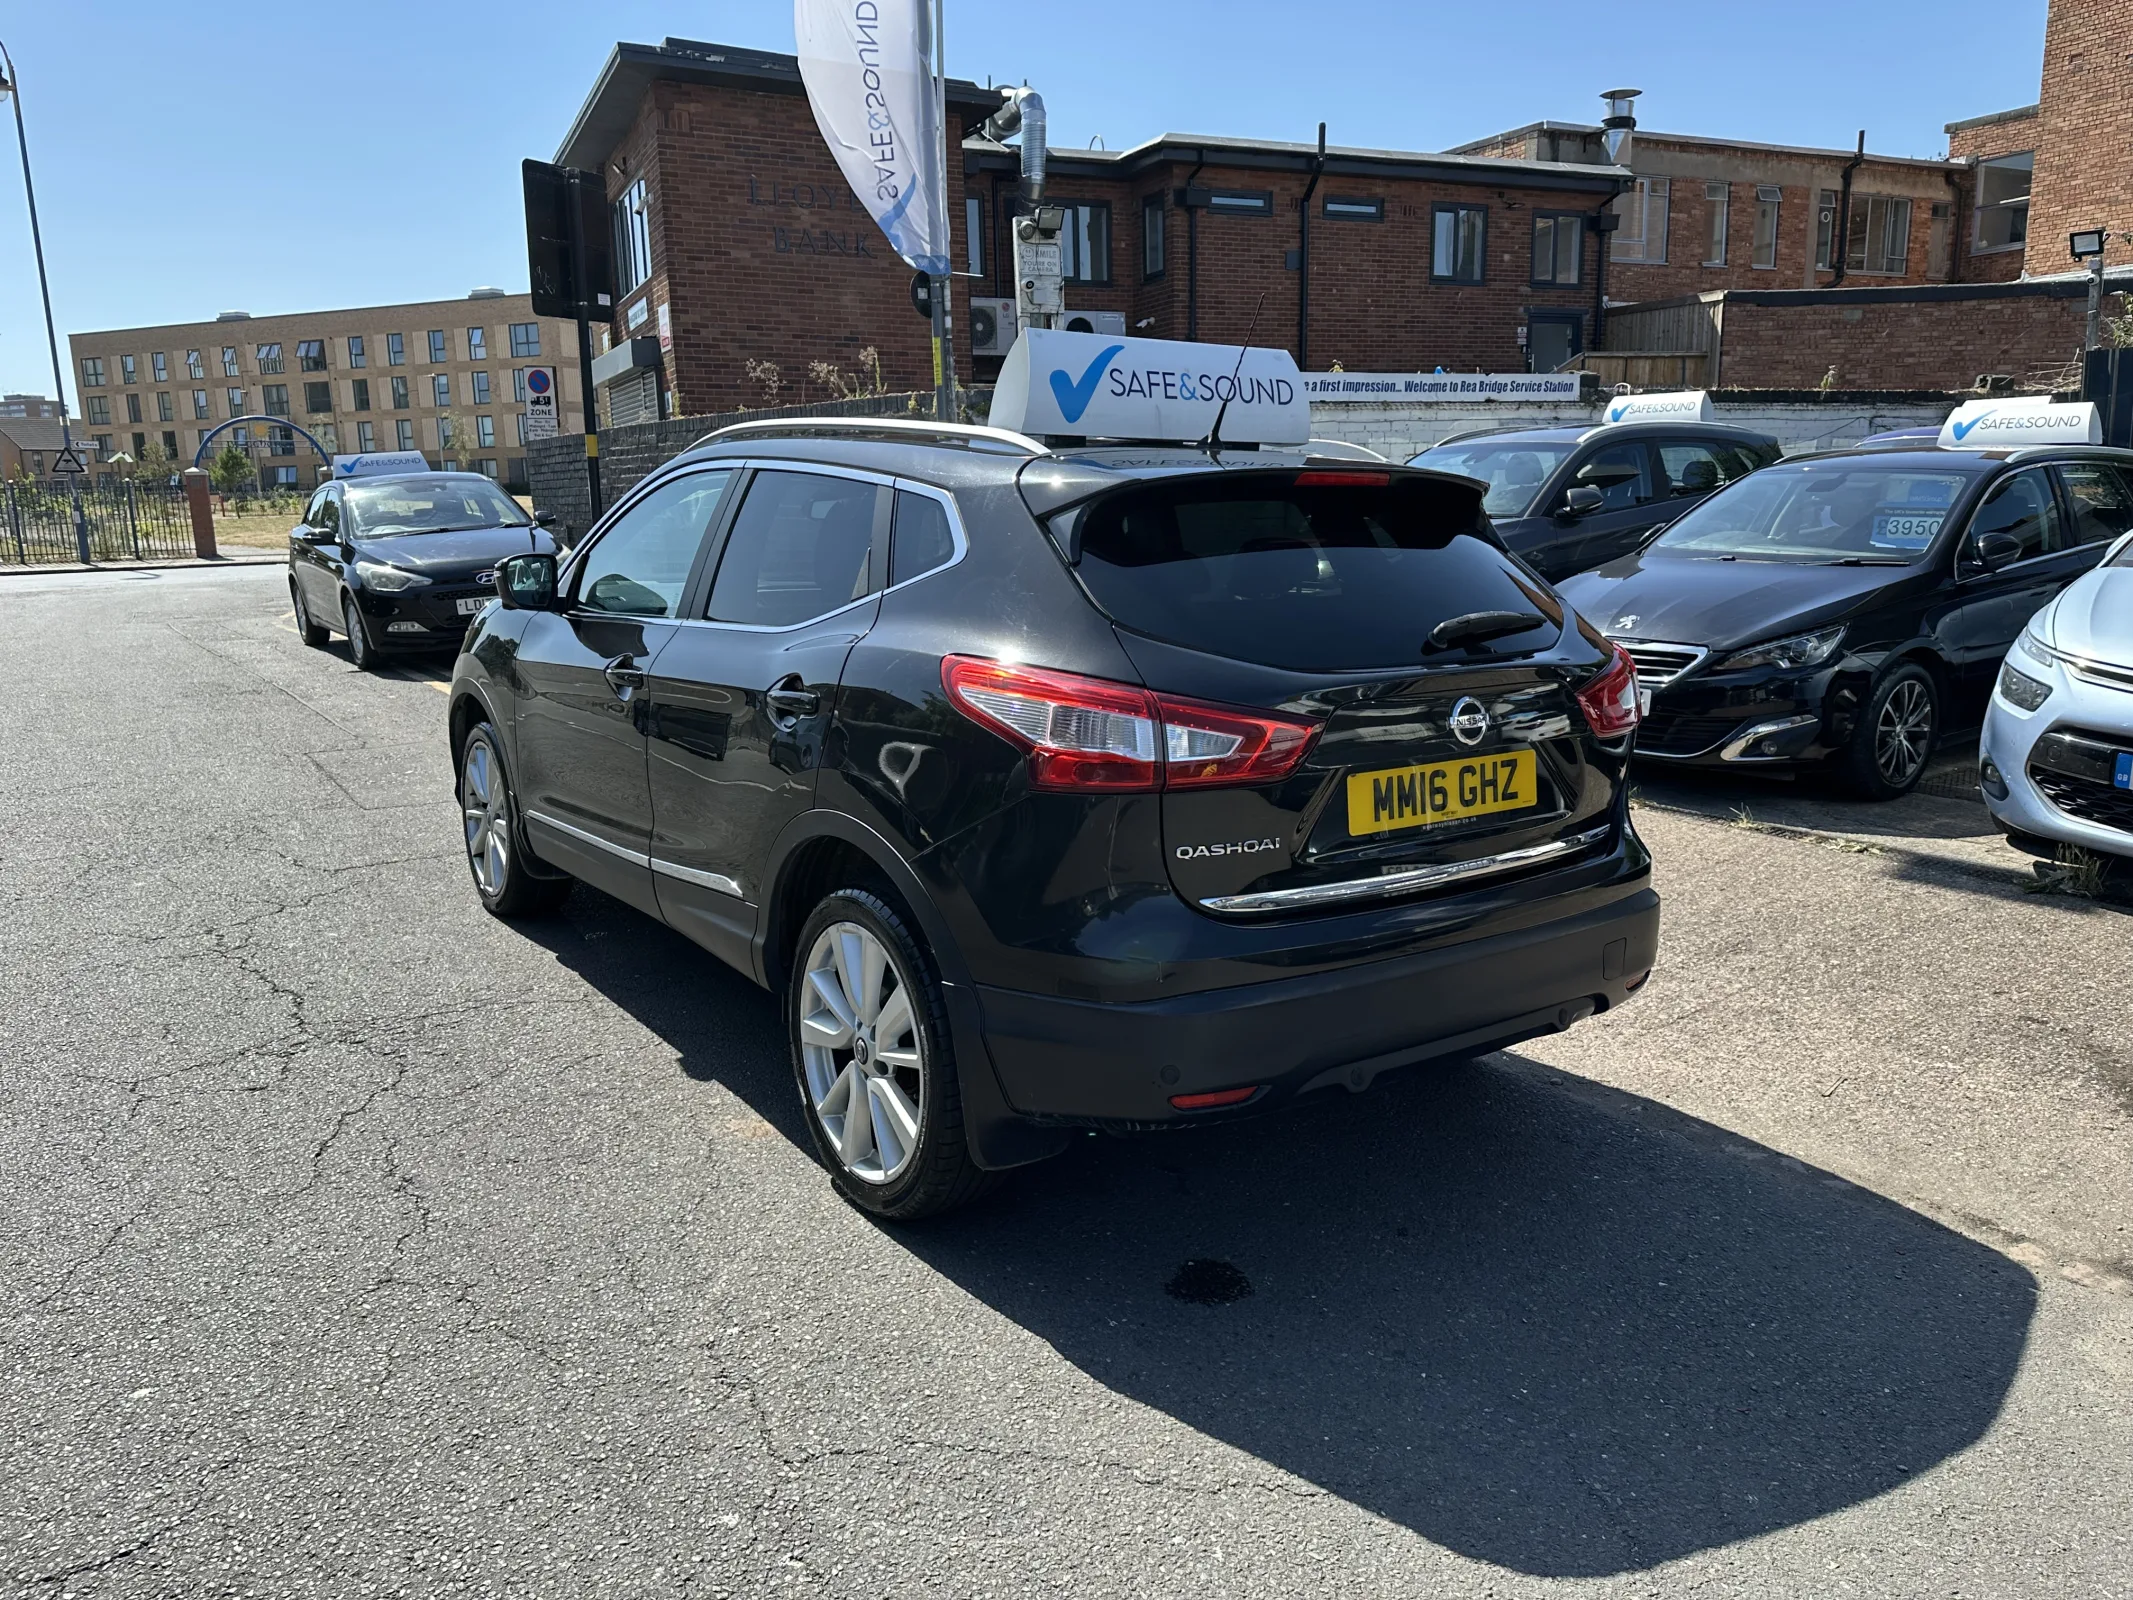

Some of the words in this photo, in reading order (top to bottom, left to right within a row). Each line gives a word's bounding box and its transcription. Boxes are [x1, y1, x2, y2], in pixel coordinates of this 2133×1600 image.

[773, 226, 878, 259] BANK
[1109, 368, 1294, 405] SAFE&SOUND
[1311, 381, 1318, 392] a
[1320, 380, 1341, 392] first
[1404, 380, 1447, 393] Welcome
[1449, 381, 1459, 392] to
[1460, 381, 1477, 393] Rea
[1479, 381, 1508, 394] Bridge
[1510, 381, 1542, 393] Service
[1543, 381, 1574, 393] Station
[1629, 402, 1696, 414] SAFE&SOUND
[1980, 416, 2081, 430] SAFE&SOUND
[359, 457, 421, 468] SAFE&SOUND
[2117, 773, 2129, 782] GB
[1373, 769, 1448, 822] MM16
[1459, 758, 1519, 808] GHZ
[1175, 837, 1280, 861] QASHQAI
